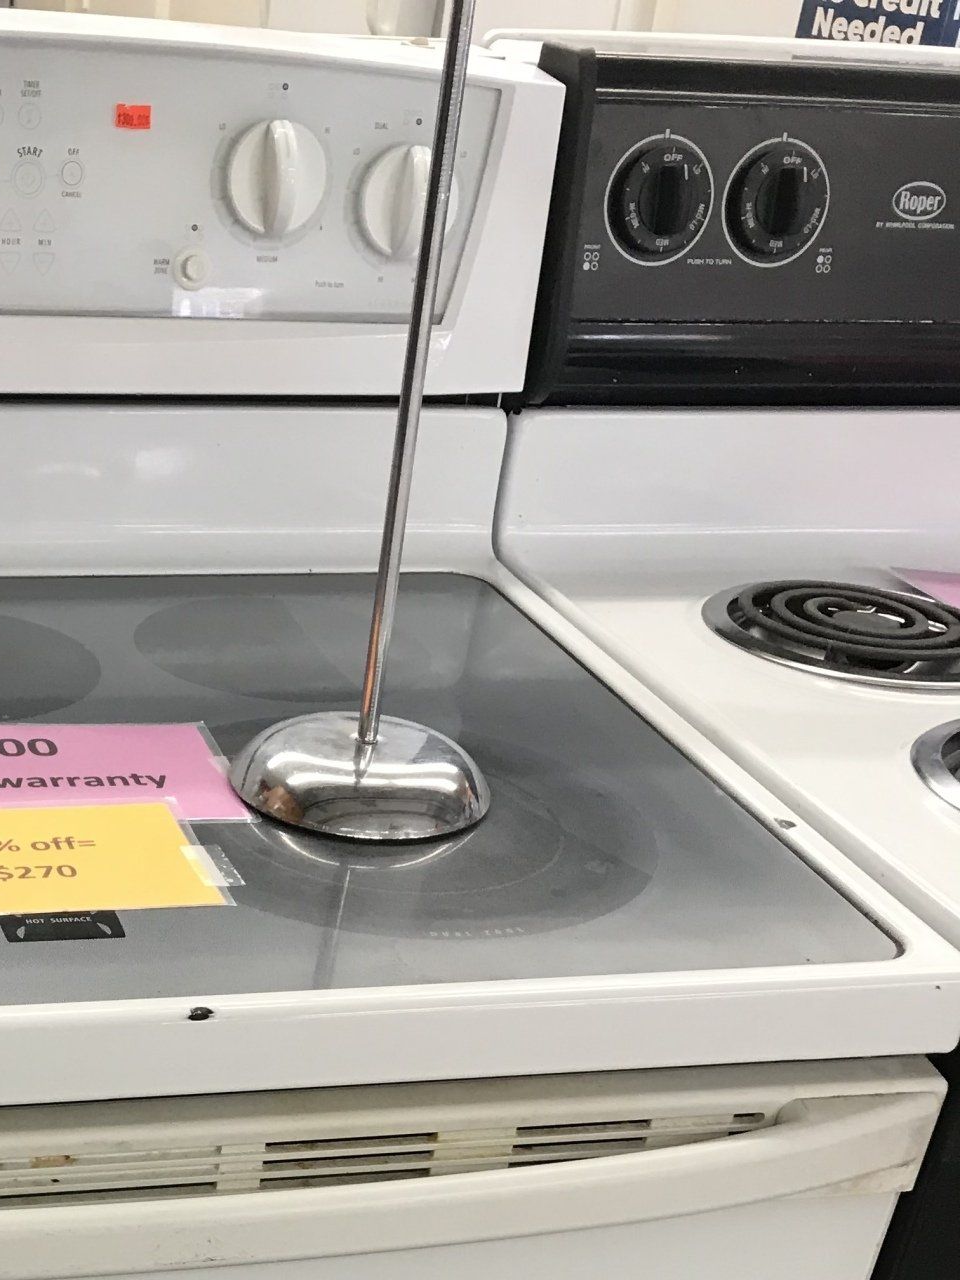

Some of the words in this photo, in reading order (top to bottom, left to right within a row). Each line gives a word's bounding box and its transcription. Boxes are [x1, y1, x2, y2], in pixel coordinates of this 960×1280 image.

[811, 6, 925, 45] Needed
[17, 145, 44, 158] START
[67, 147, 80, 156] OFF
[663, 153, 684, 162] OFF
[783, 156, 803, 165] OFF
[899, 190, 941, 214] Roper
[29, 836, 97, 853] off=
[49, 916, 92, 924] SURFACE
